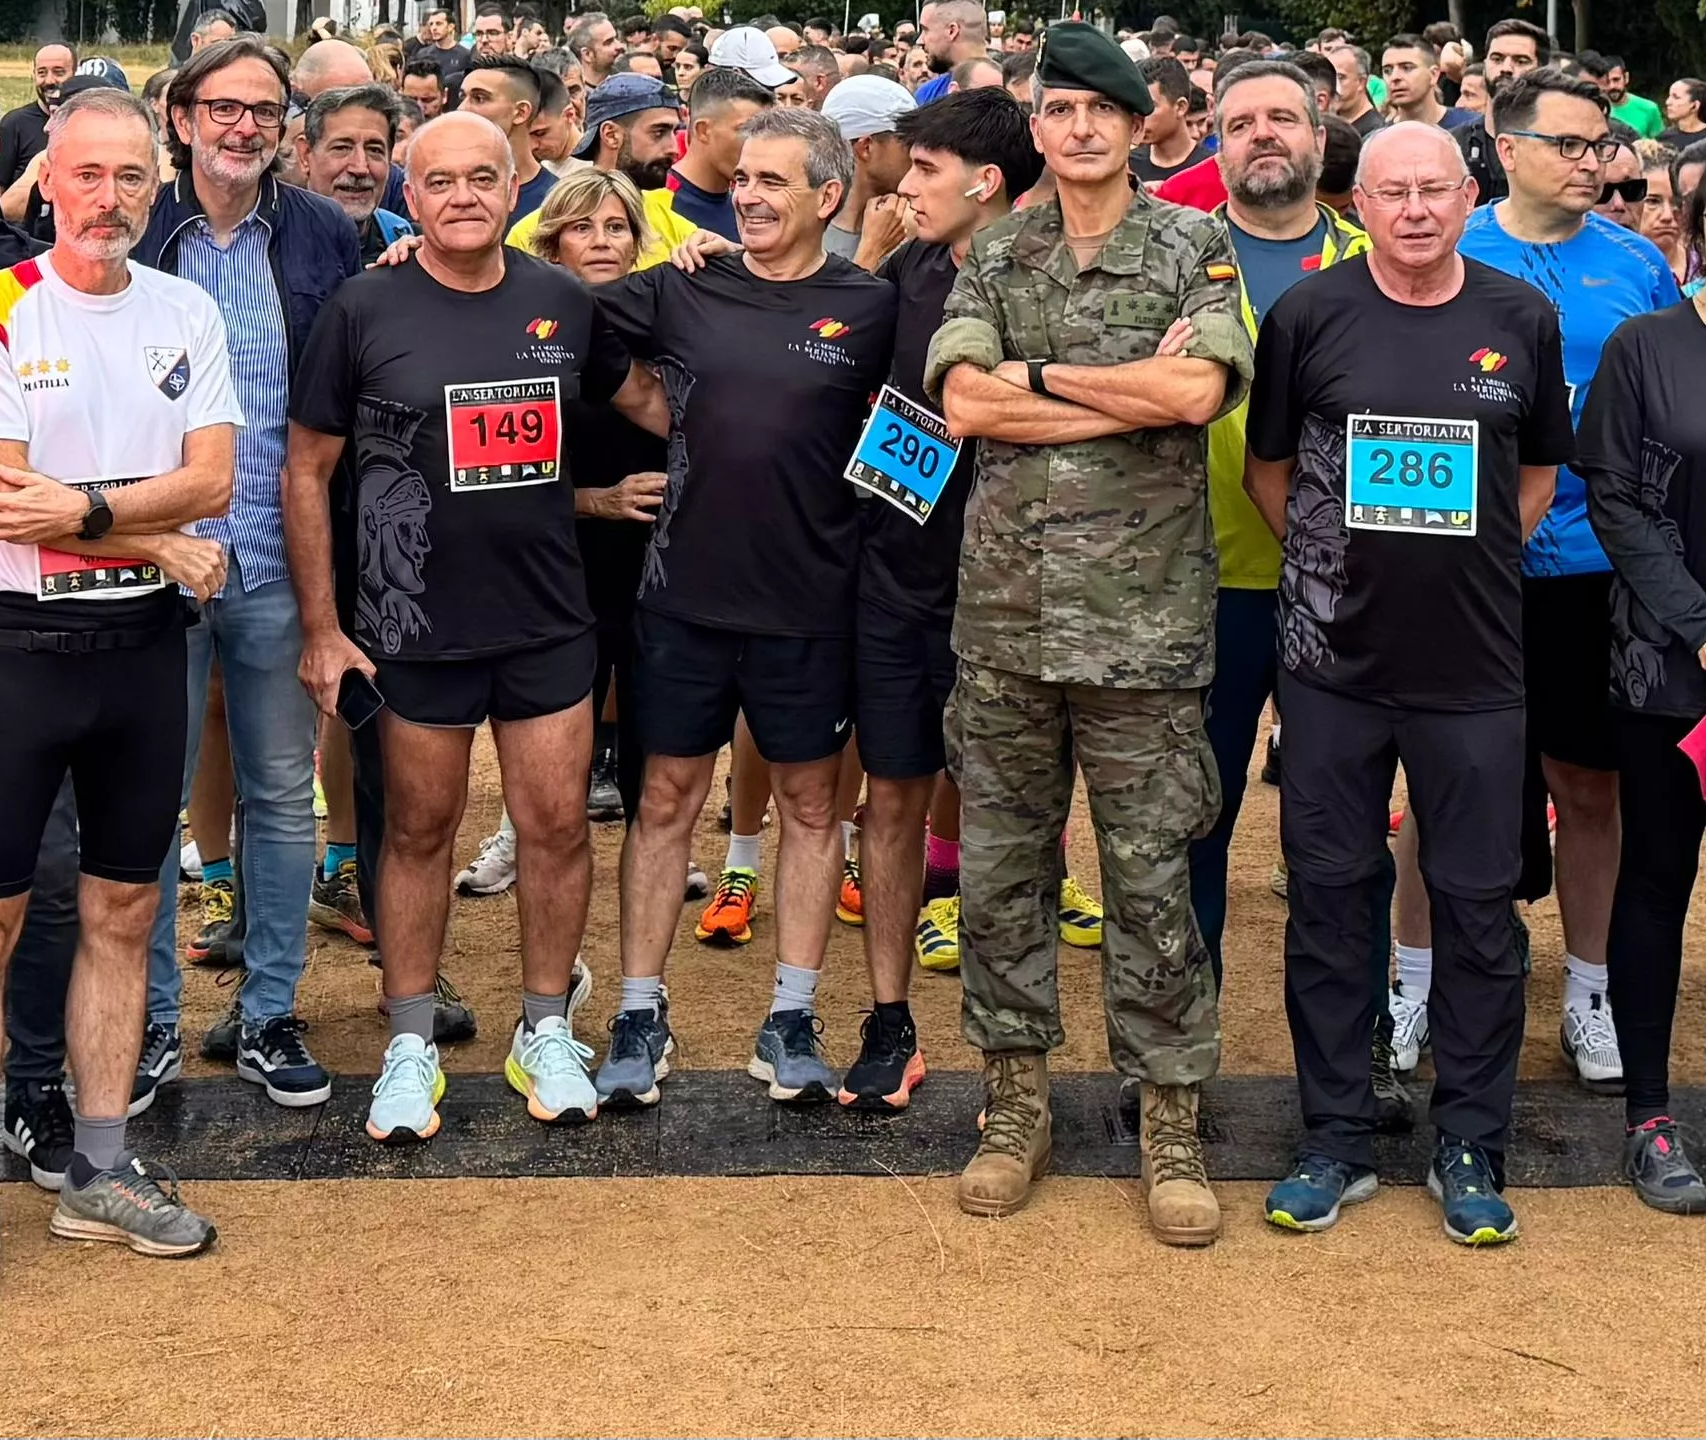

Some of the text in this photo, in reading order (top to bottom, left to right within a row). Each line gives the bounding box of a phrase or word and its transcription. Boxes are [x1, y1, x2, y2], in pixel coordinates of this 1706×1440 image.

[23, 378, 70, 392] MATILLA
[473, 384, 554, 401] SERTORIANA
[470, 409, 543, 447] 149
[1354, 420, 1472, 440] LA SERTORIANA
[878, 422, 940, 479] 290
[1369, 448, 1453, 489] 286
